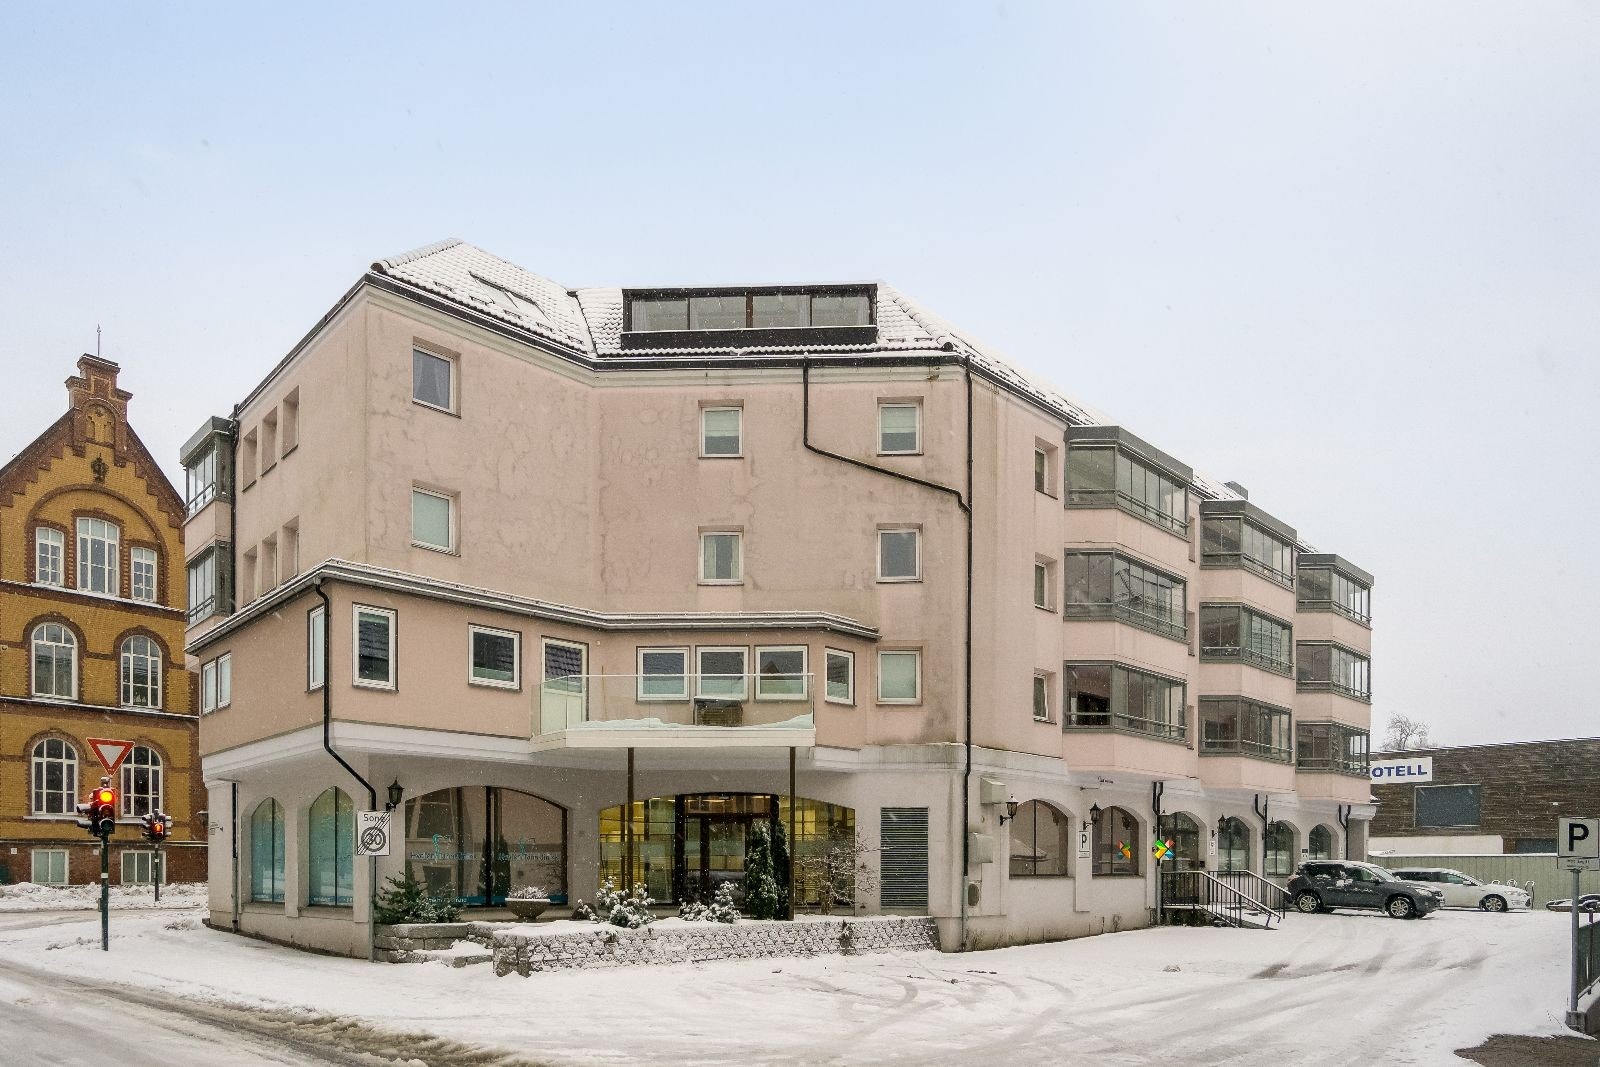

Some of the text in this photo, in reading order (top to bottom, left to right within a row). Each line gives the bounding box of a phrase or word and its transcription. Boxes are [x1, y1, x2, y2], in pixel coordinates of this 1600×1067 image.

[1371, 764, 1428, 778] OTELL
[1081, 834, 1088, 849] P
[1568, 823, 1590, 852] P
